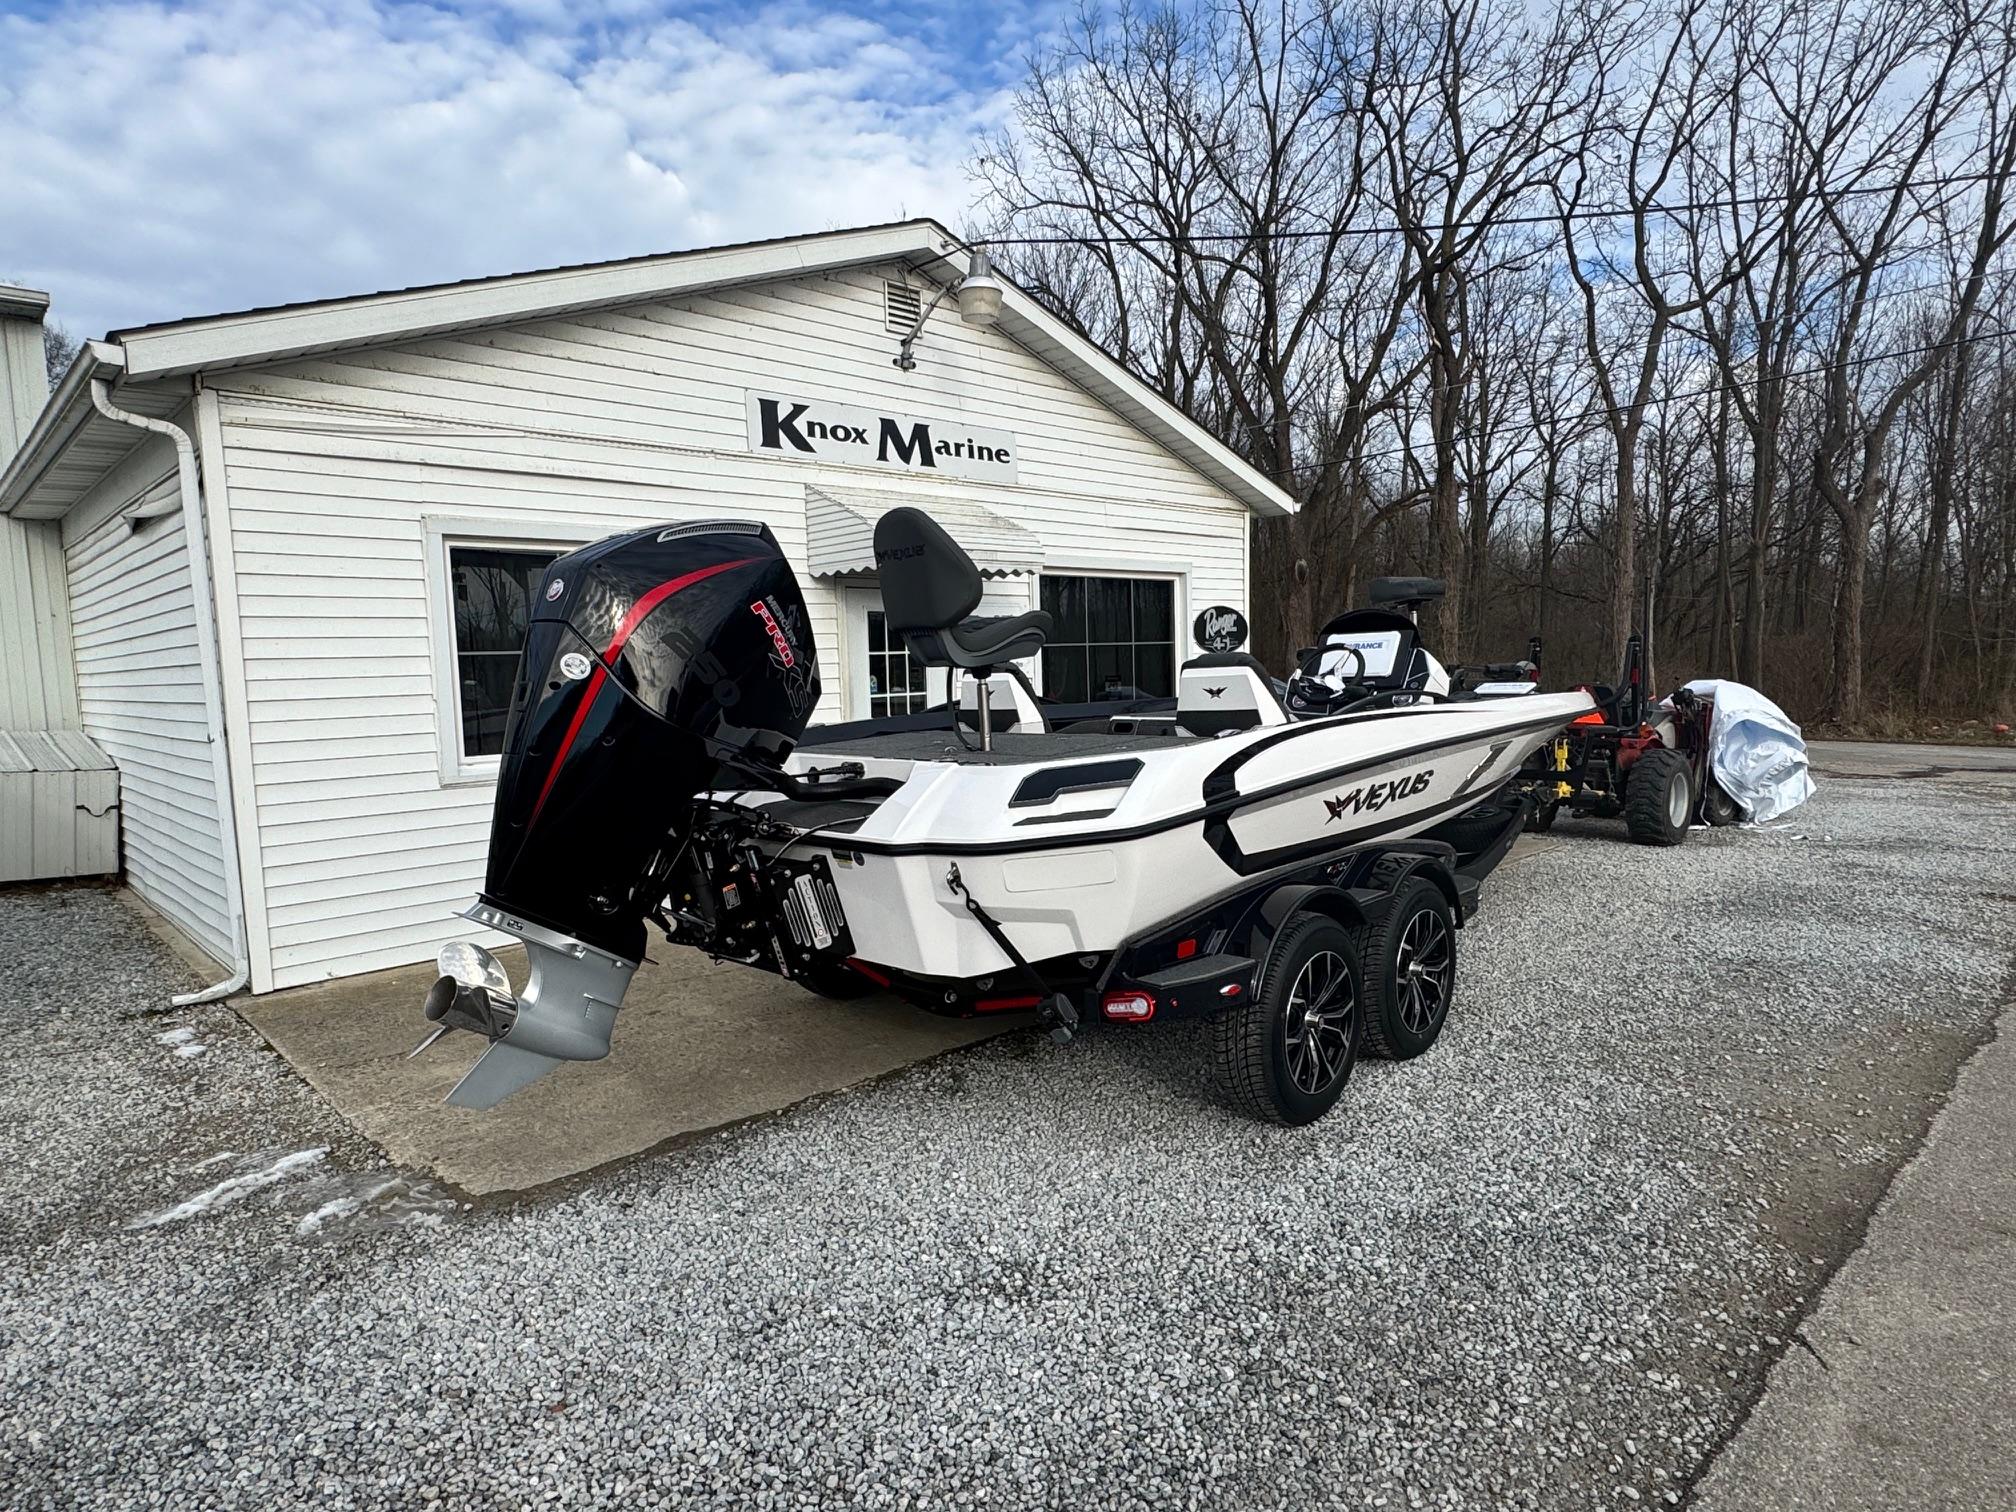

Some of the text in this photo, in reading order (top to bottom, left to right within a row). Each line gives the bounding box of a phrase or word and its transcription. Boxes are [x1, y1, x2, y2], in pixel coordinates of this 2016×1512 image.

[757, 398, 1011, 468] Knox Marine
[750, 600, 795, 669] PRO
[765, 594, 798, 646] MERCURY
[1203, 608, 1237, 639] Ranger
[1353, 769, 1435, 816] VEXUS
